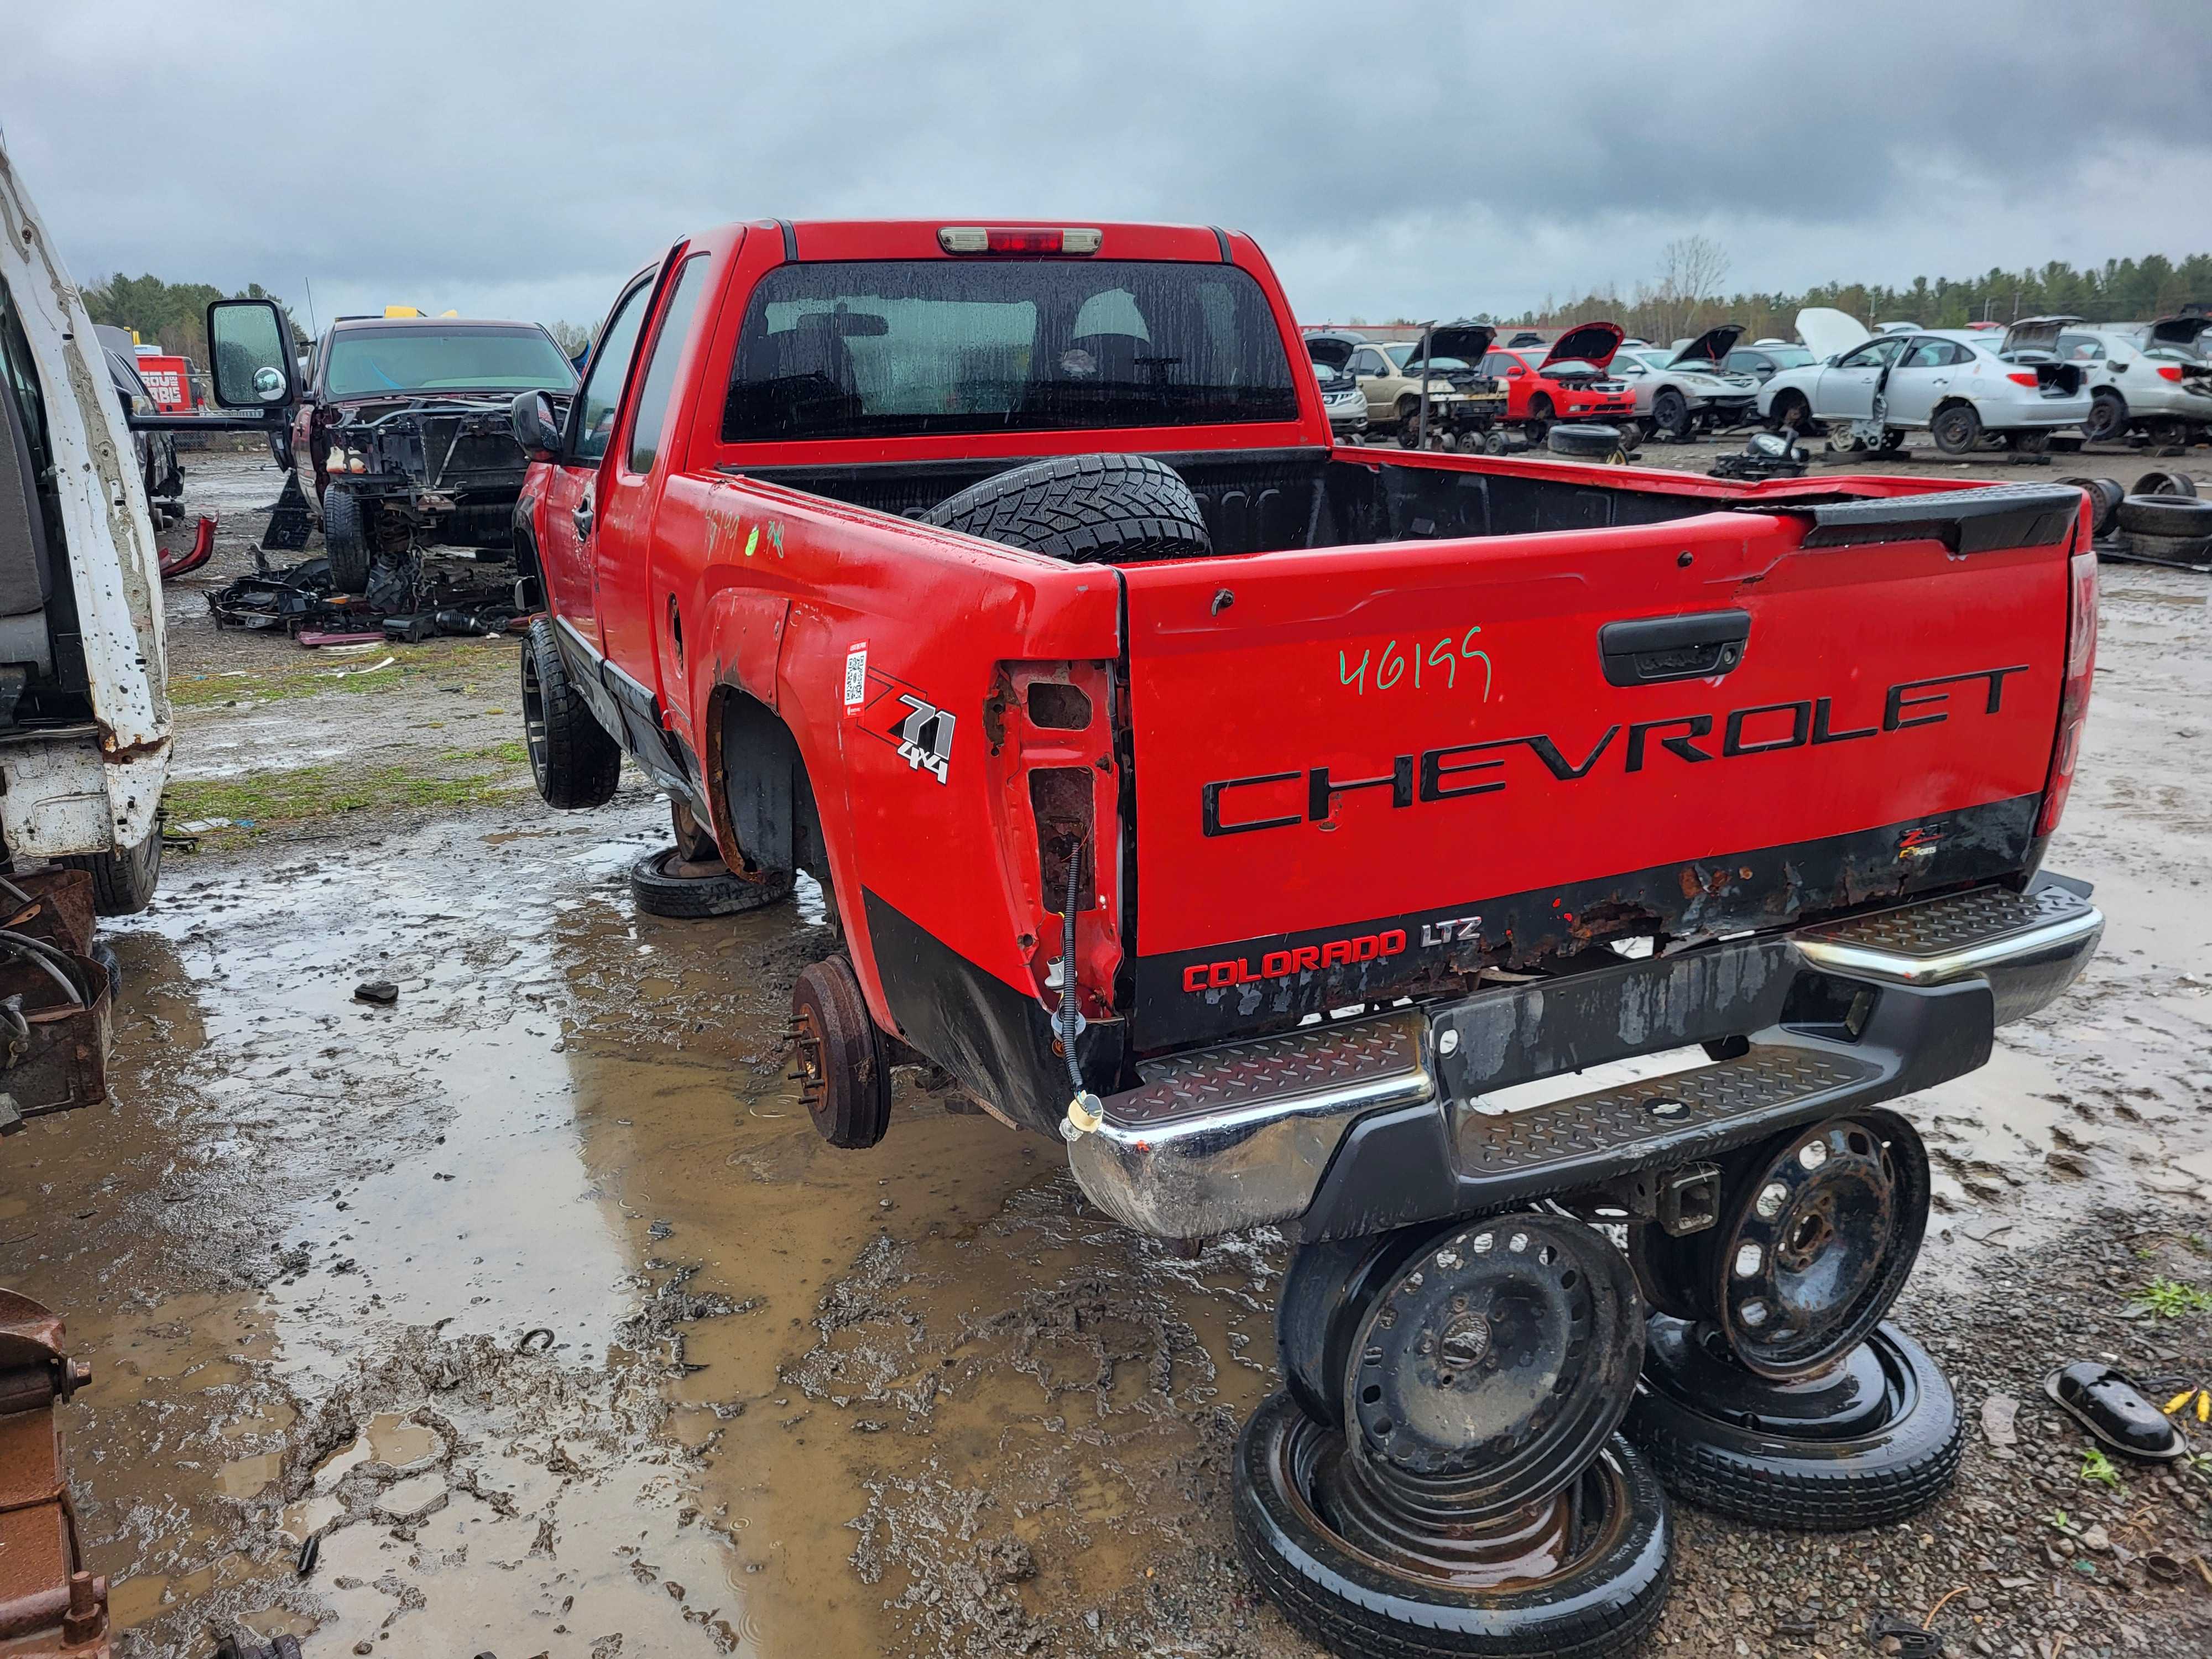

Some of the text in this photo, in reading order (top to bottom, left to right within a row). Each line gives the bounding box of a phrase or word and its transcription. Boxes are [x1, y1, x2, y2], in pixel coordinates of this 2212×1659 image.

[1202, 665, 2029, 837] CHEVROLET
[1182, 916, 1482, 993] COLORADO LTZ
